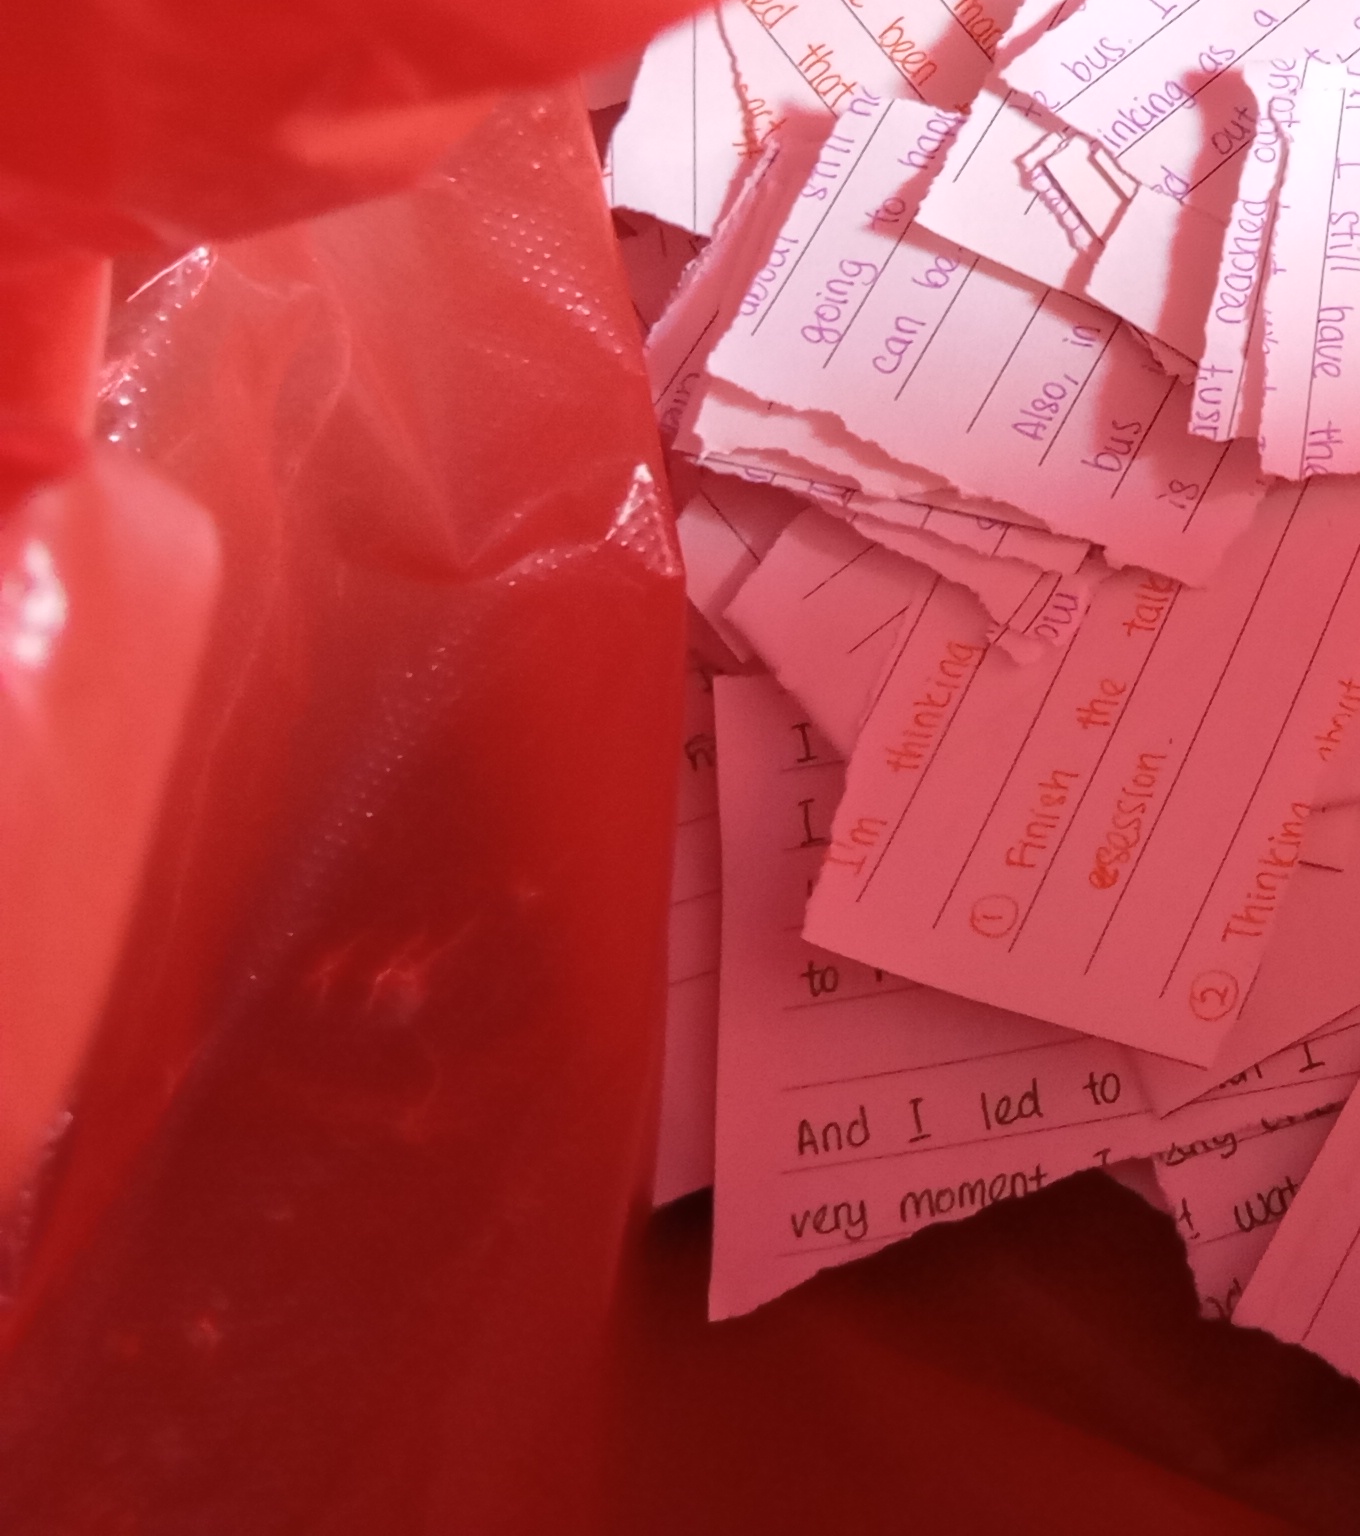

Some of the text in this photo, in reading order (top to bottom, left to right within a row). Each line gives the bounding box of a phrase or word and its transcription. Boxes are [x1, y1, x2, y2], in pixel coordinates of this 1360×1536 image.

[798, 43, 859, 109] that
[877, 16, 938, 86] been
[1198, 44, 1236, 77] as
[1253, 9, 1279, 29] a
[1216, 200, 1268, 325] reached
[1328, 211, 1360, 273] still
[800, 258, 879, 346] going
[872, 253, 963, 375] can be
[1062, 324, 1101, 348] in
[1311, 305, 1355, 380] have
[1082, 419, 1143, 476] bus
[886, 638, 988, 775] thinking
[1075, 678, 1128, 730] the
[801, 960, 838, 998] to
[796, 1070, 1121, 1158] And I led to
[789, 1164, 1049, 1241] very moment
